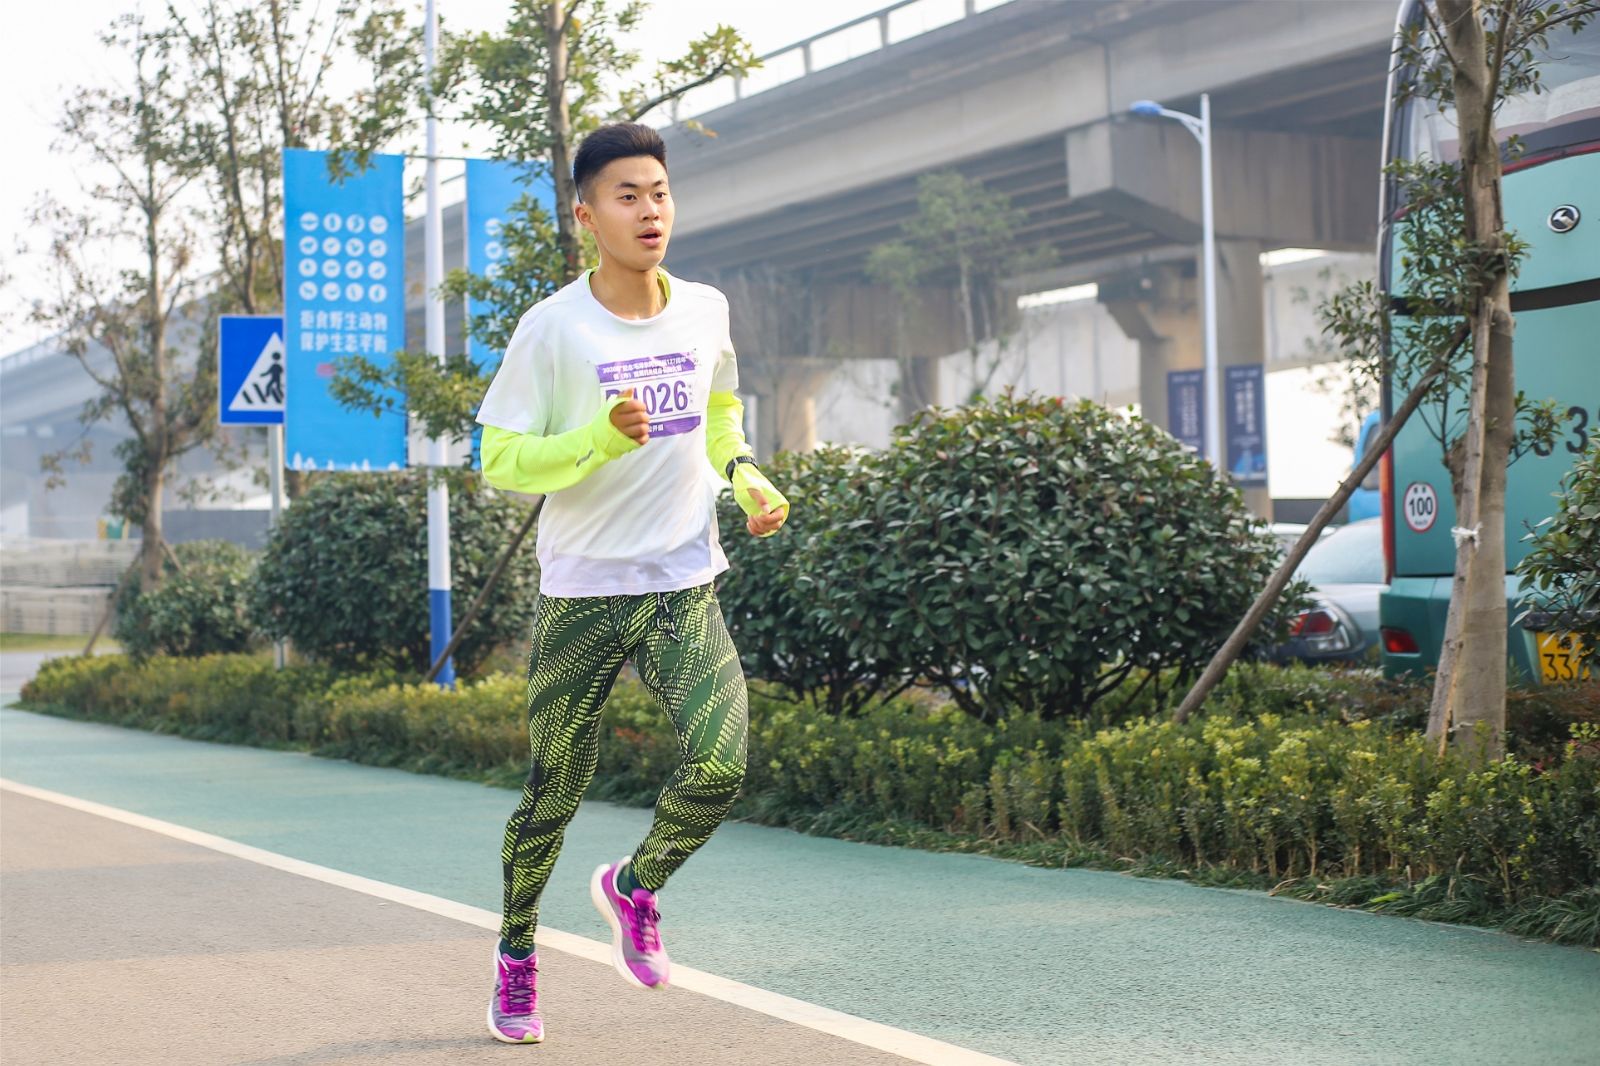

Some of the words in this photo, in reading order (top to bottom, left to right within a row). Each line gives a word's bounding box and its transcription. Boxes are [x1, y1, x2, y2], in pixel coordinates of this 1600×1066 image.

[300, 310, 387, 331] 拒食野生动物
[300, 331, 387, 353] 保护生态平衡
[606, 380, 689, 416] 026
[1408, 496, 1433, 517] 100
[1542, 653, 1591, 682] 33
